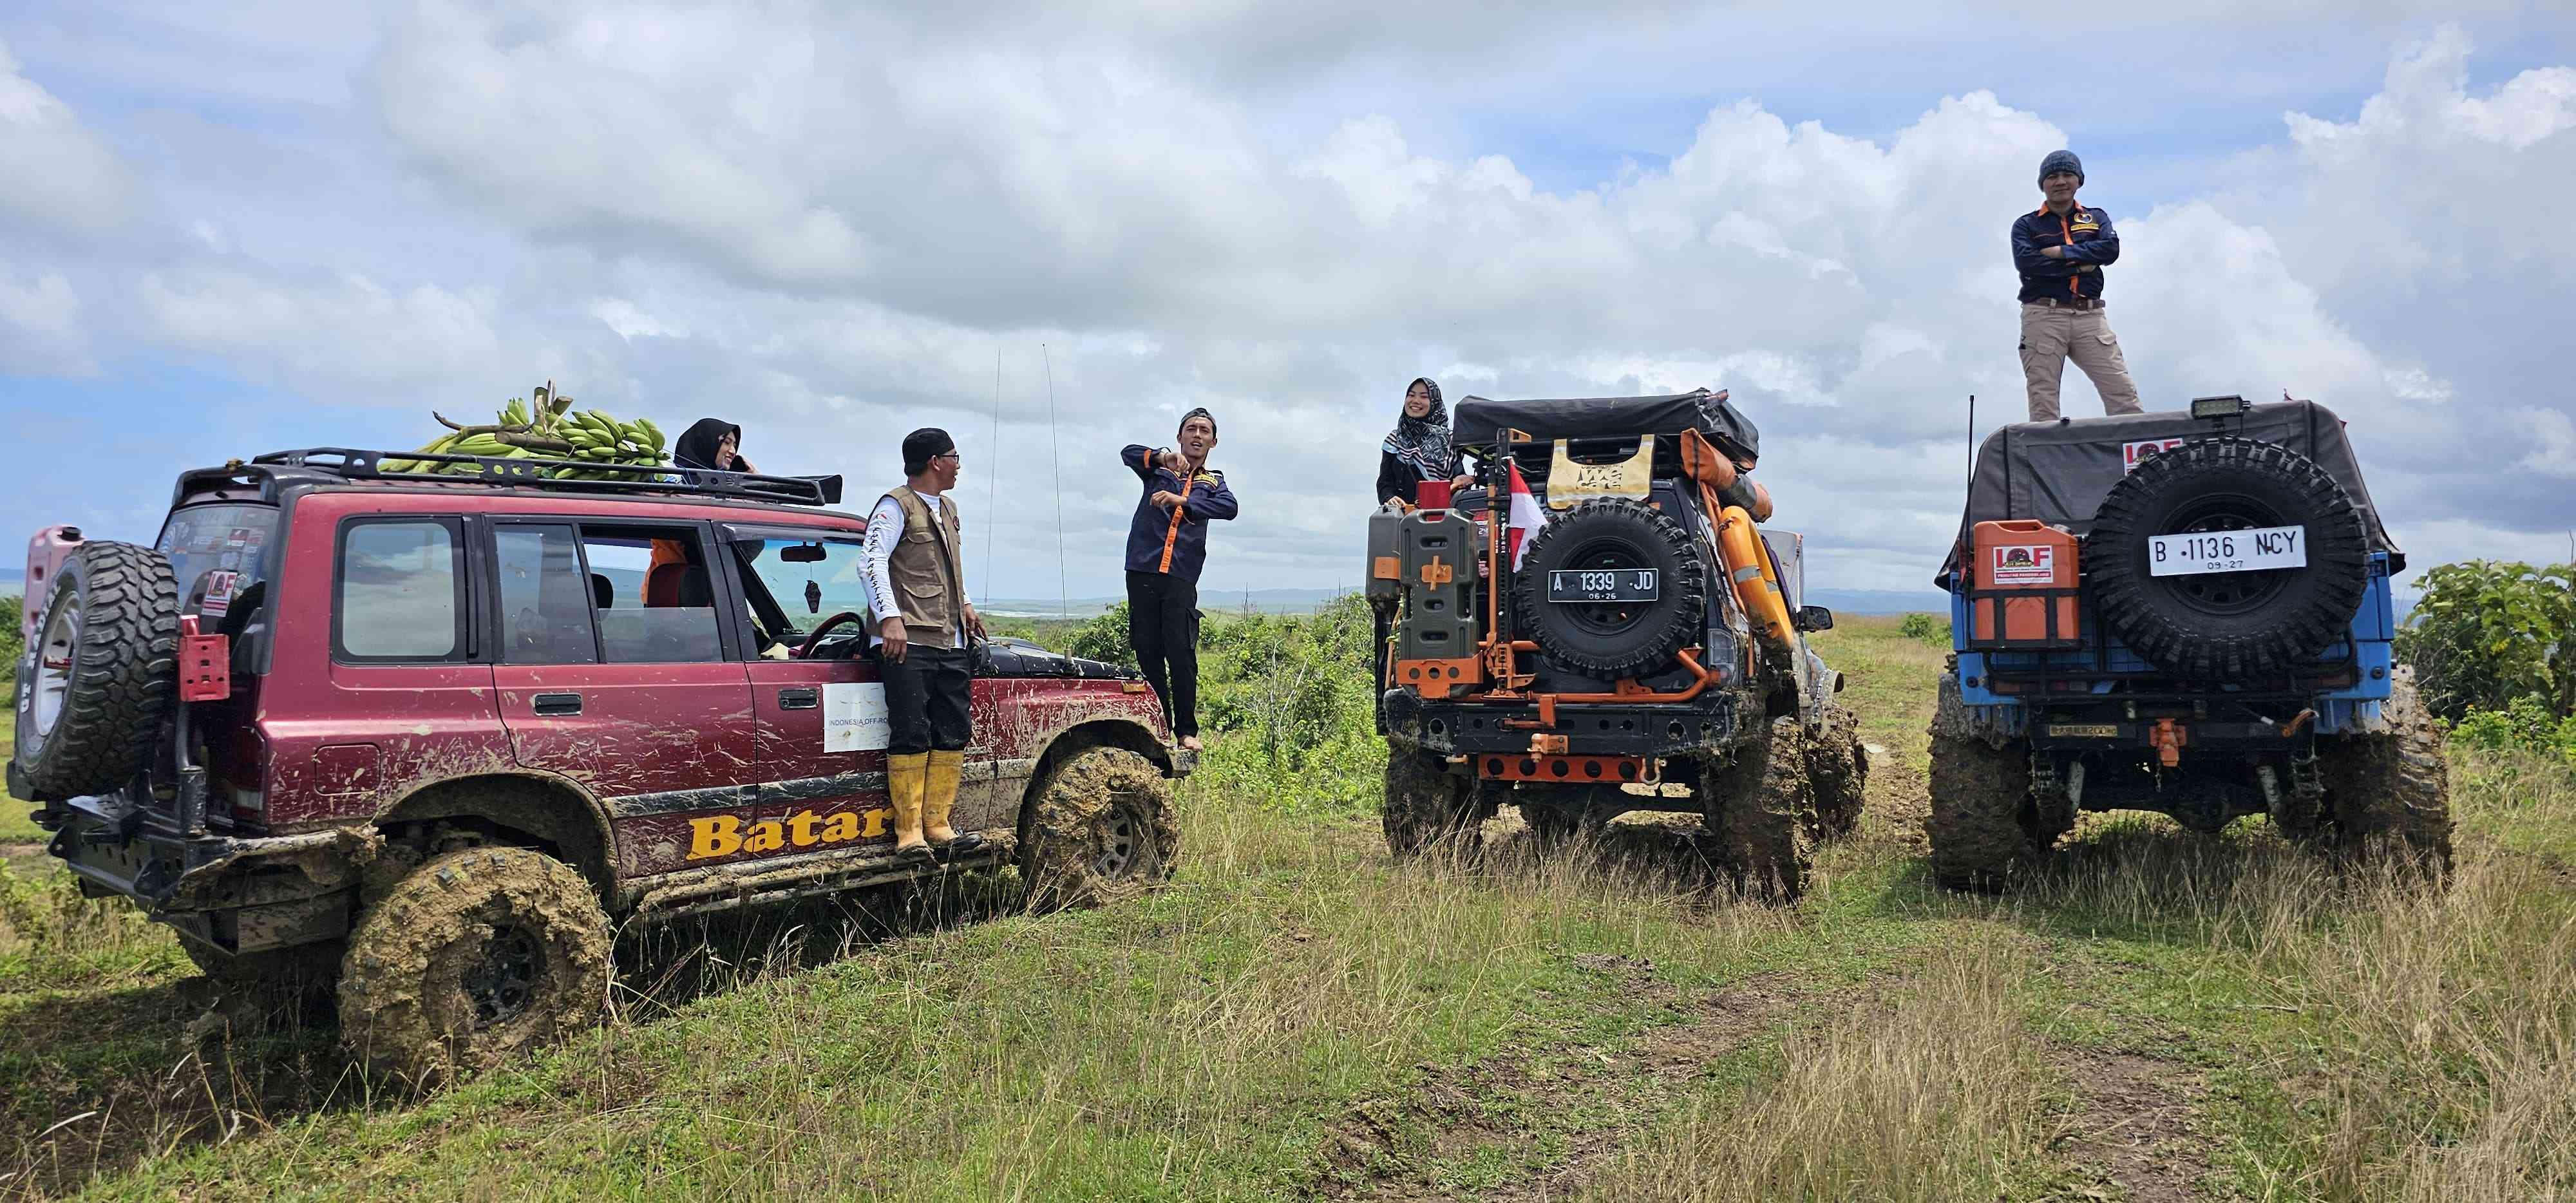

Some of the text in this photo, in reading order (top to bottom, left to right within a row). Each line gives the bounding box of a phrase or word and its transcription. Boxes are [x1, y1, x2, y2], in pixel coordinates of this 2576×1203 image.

[2155, 531, 2297, 562] B 1136 NCY
[867, 527, 886, 612] FREE PALESTINE
[1553, 571, 1653, 591] A 1339 JD
[20, 683, 31, 713] GT
[829, 718, 864, 726] INDONESIA
